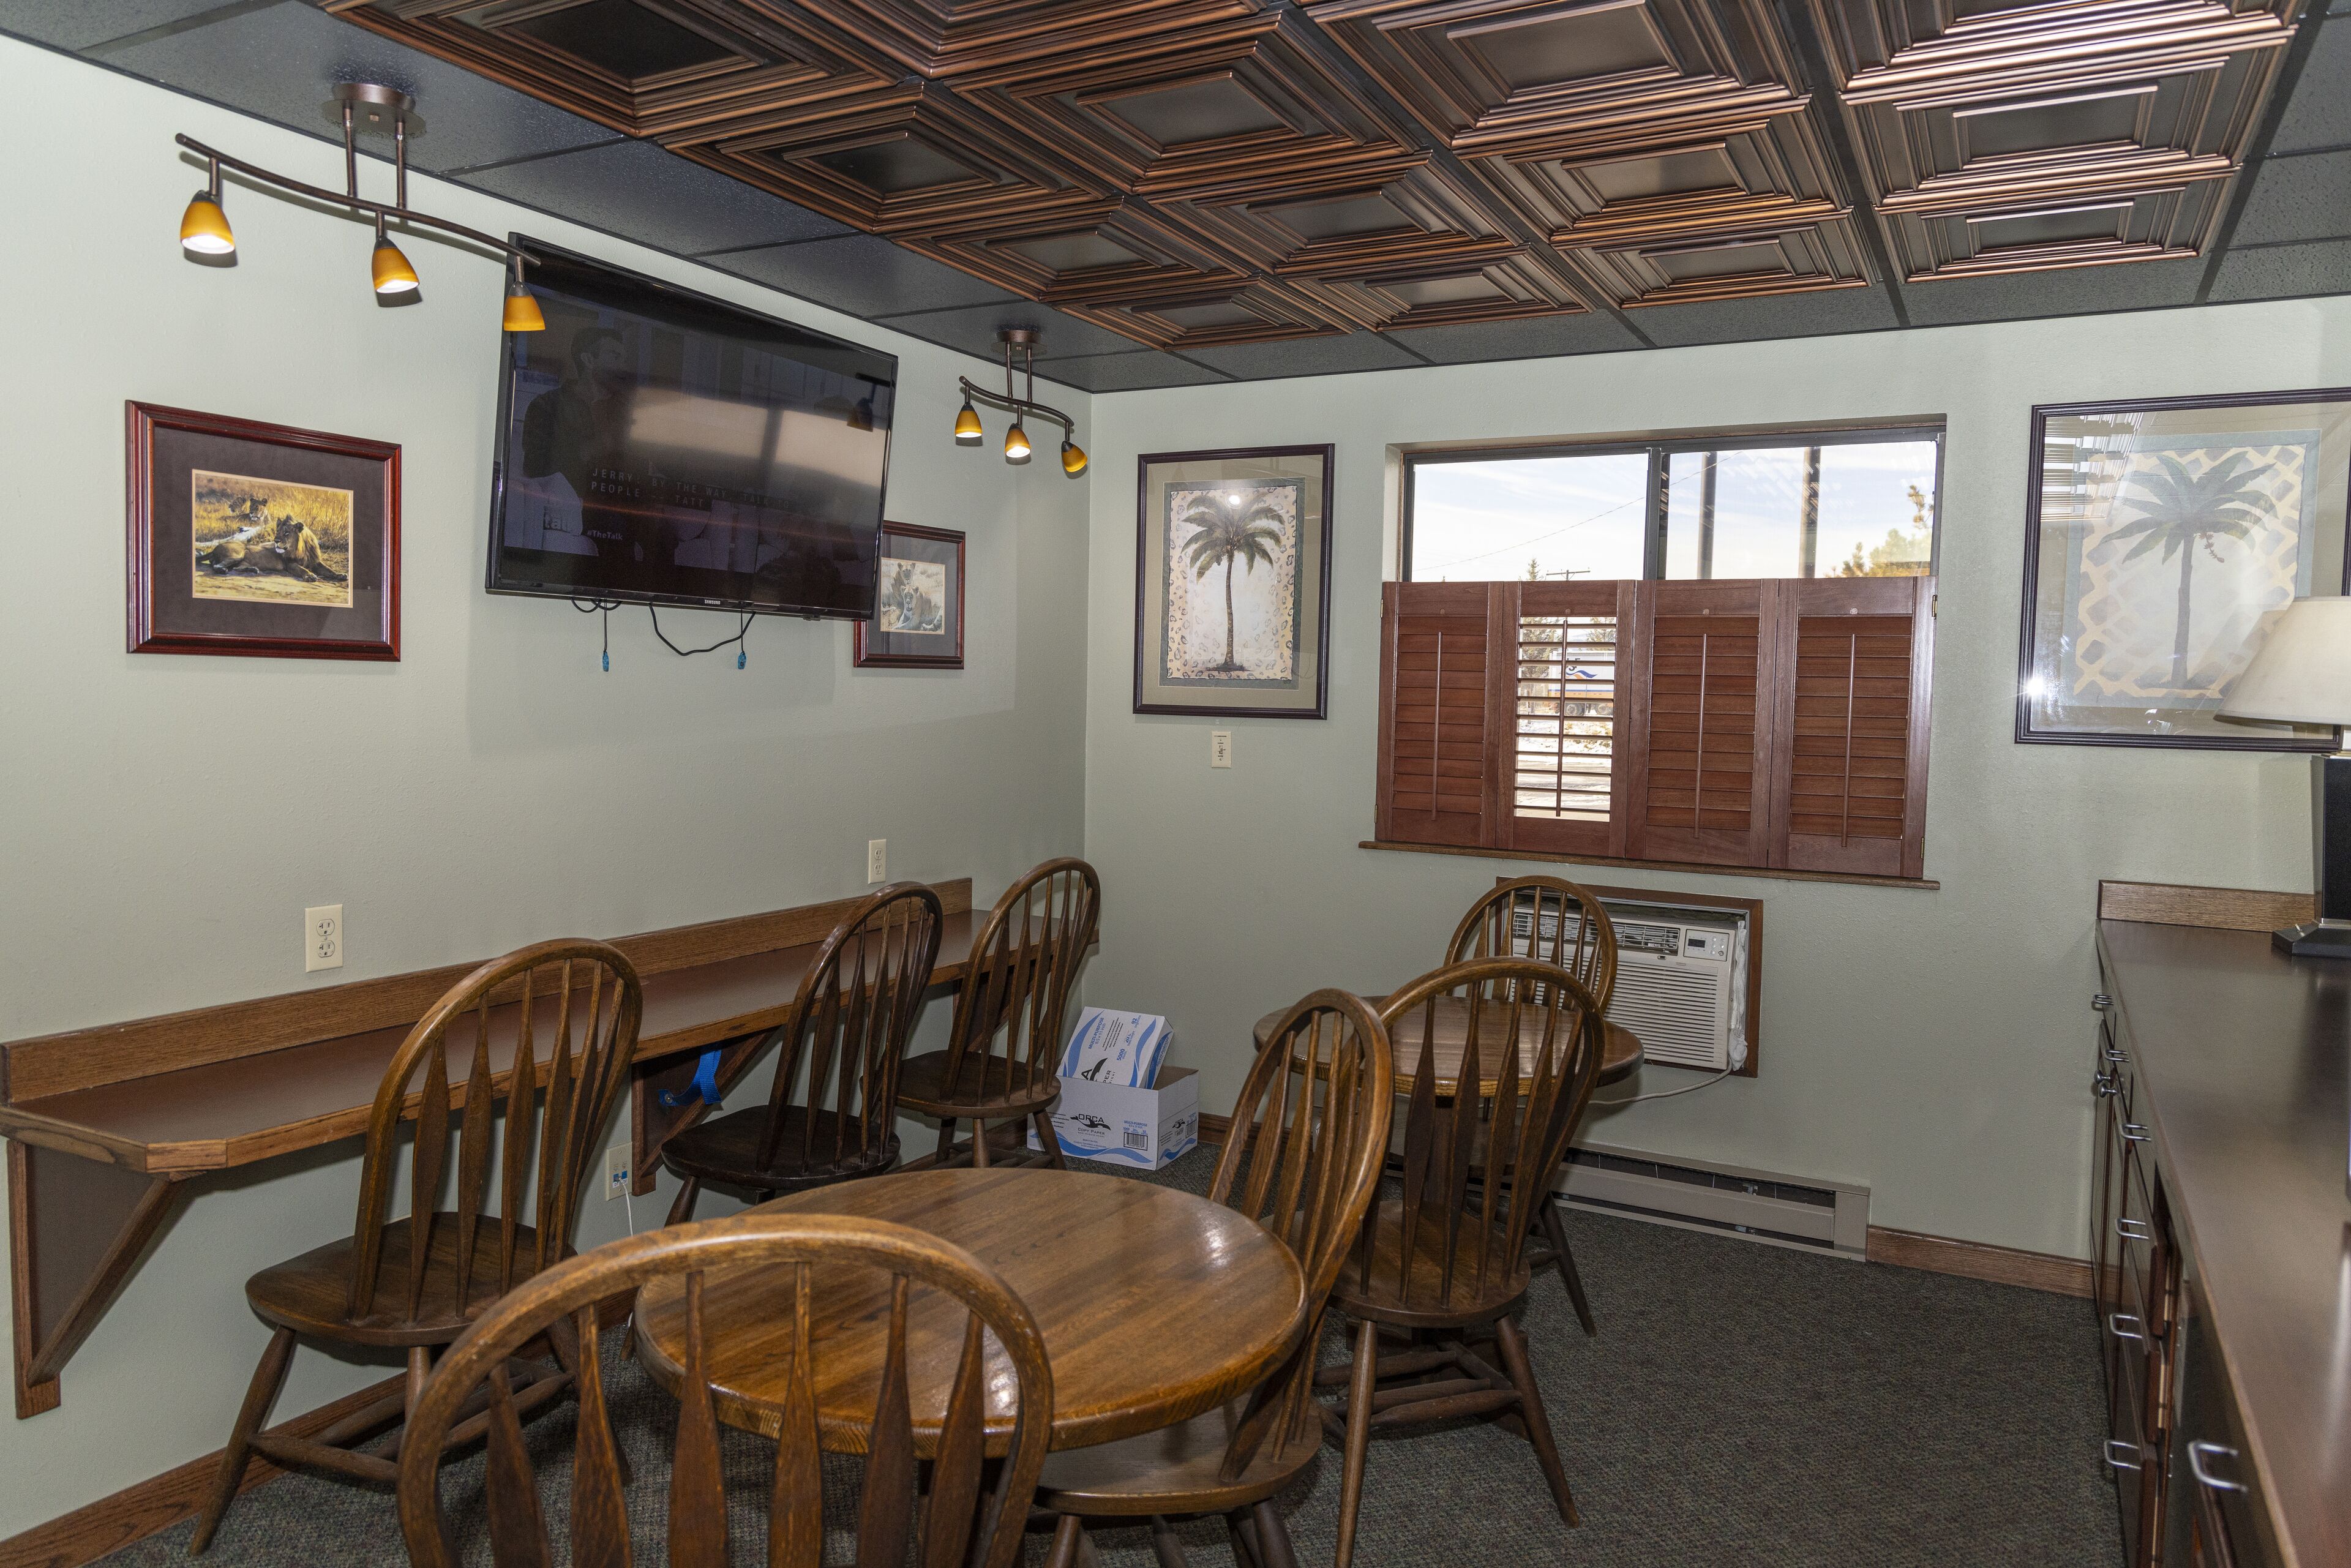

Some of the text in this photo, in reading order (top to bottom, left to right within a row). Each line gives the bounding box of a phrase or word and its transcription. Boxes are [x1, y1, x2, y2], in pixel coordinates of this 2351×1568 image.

[591, 481, 640, 498] PEOPLE
[675, 495, 703, 508] TATT
[651, 478, 666, 488] BY
[675, 481, 697, 494] THE
[744, 493, 769, 507] TALK
[587, 530, 623, 541] #TheTalk
[1088, 1017, 1104, 1049] MULTI-PURPOSE
[1116, 1048, 1125, 1061] 5000
[1103, 1070, 1111, 1083] PER
[1078, 1114, 1104, 1123] ORCA
